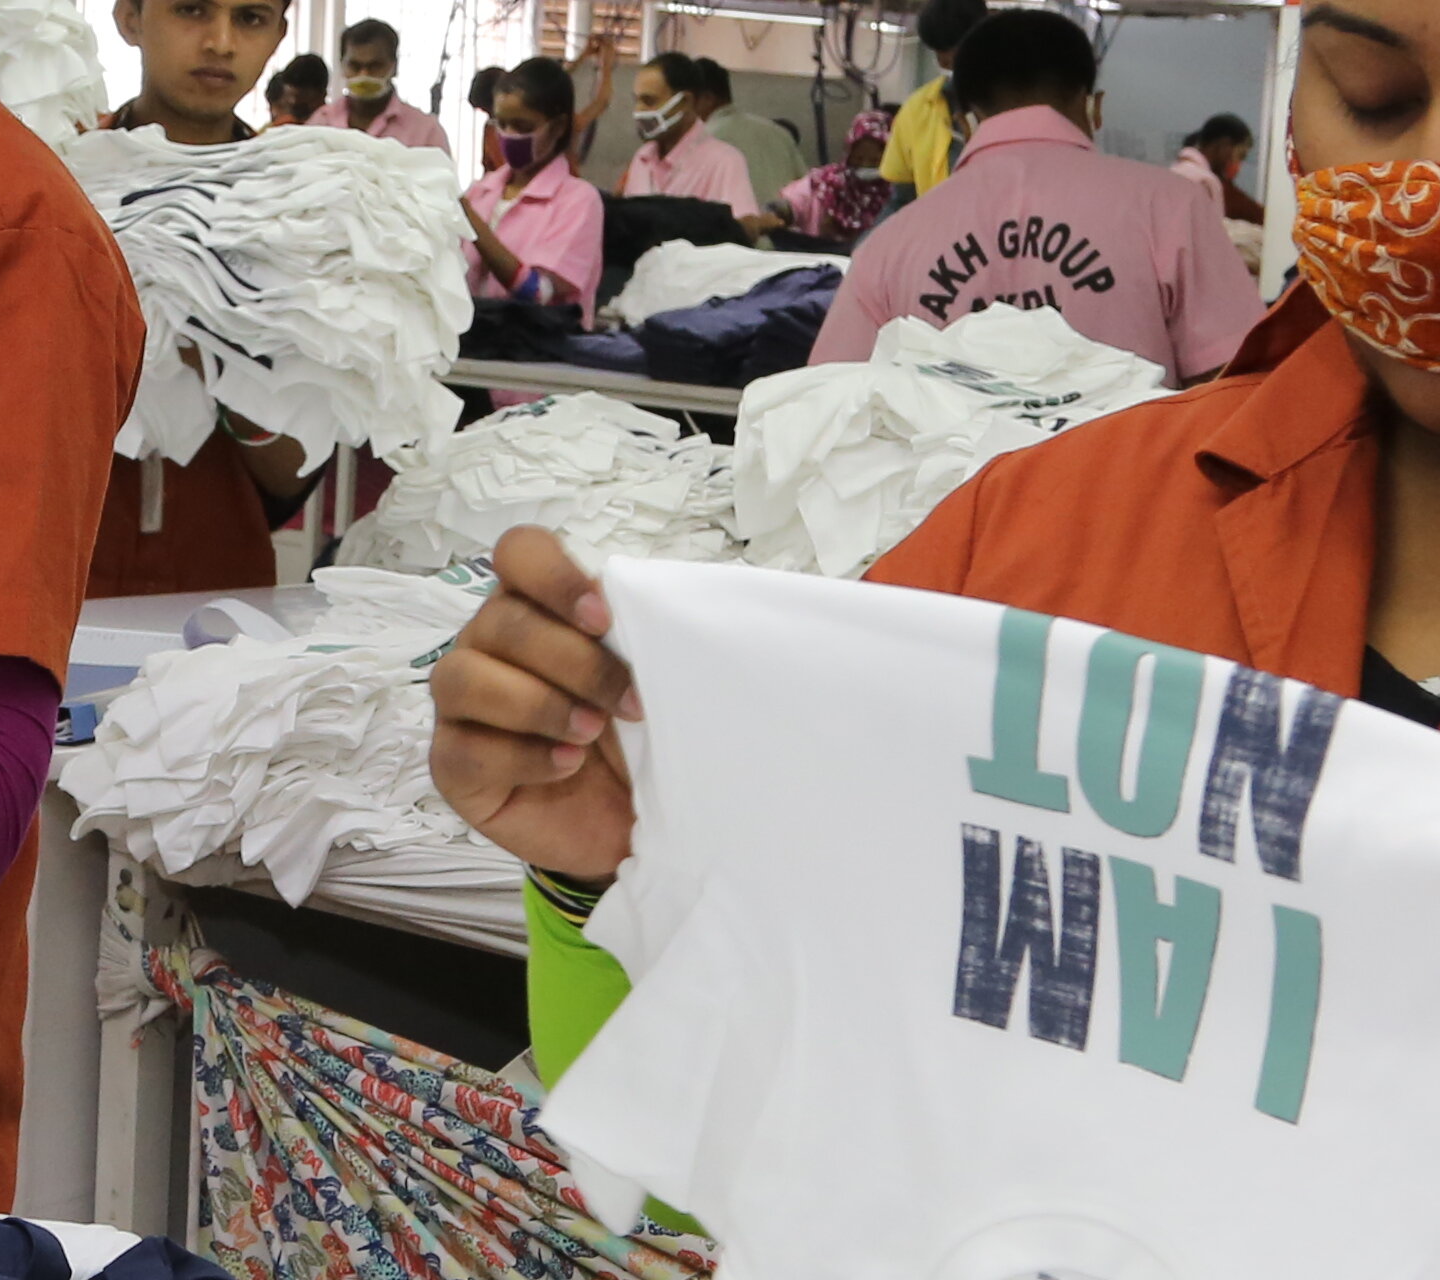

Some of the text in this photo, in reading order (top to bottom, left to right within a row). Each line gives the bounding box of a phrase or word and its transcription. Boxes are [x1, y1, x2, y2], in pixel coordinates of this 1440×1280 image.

[920, 216, 1115, 320] AKH GROUP
[965, 605, 1346, 883] NOT
[952, 821, 1322, 1126] I AM
